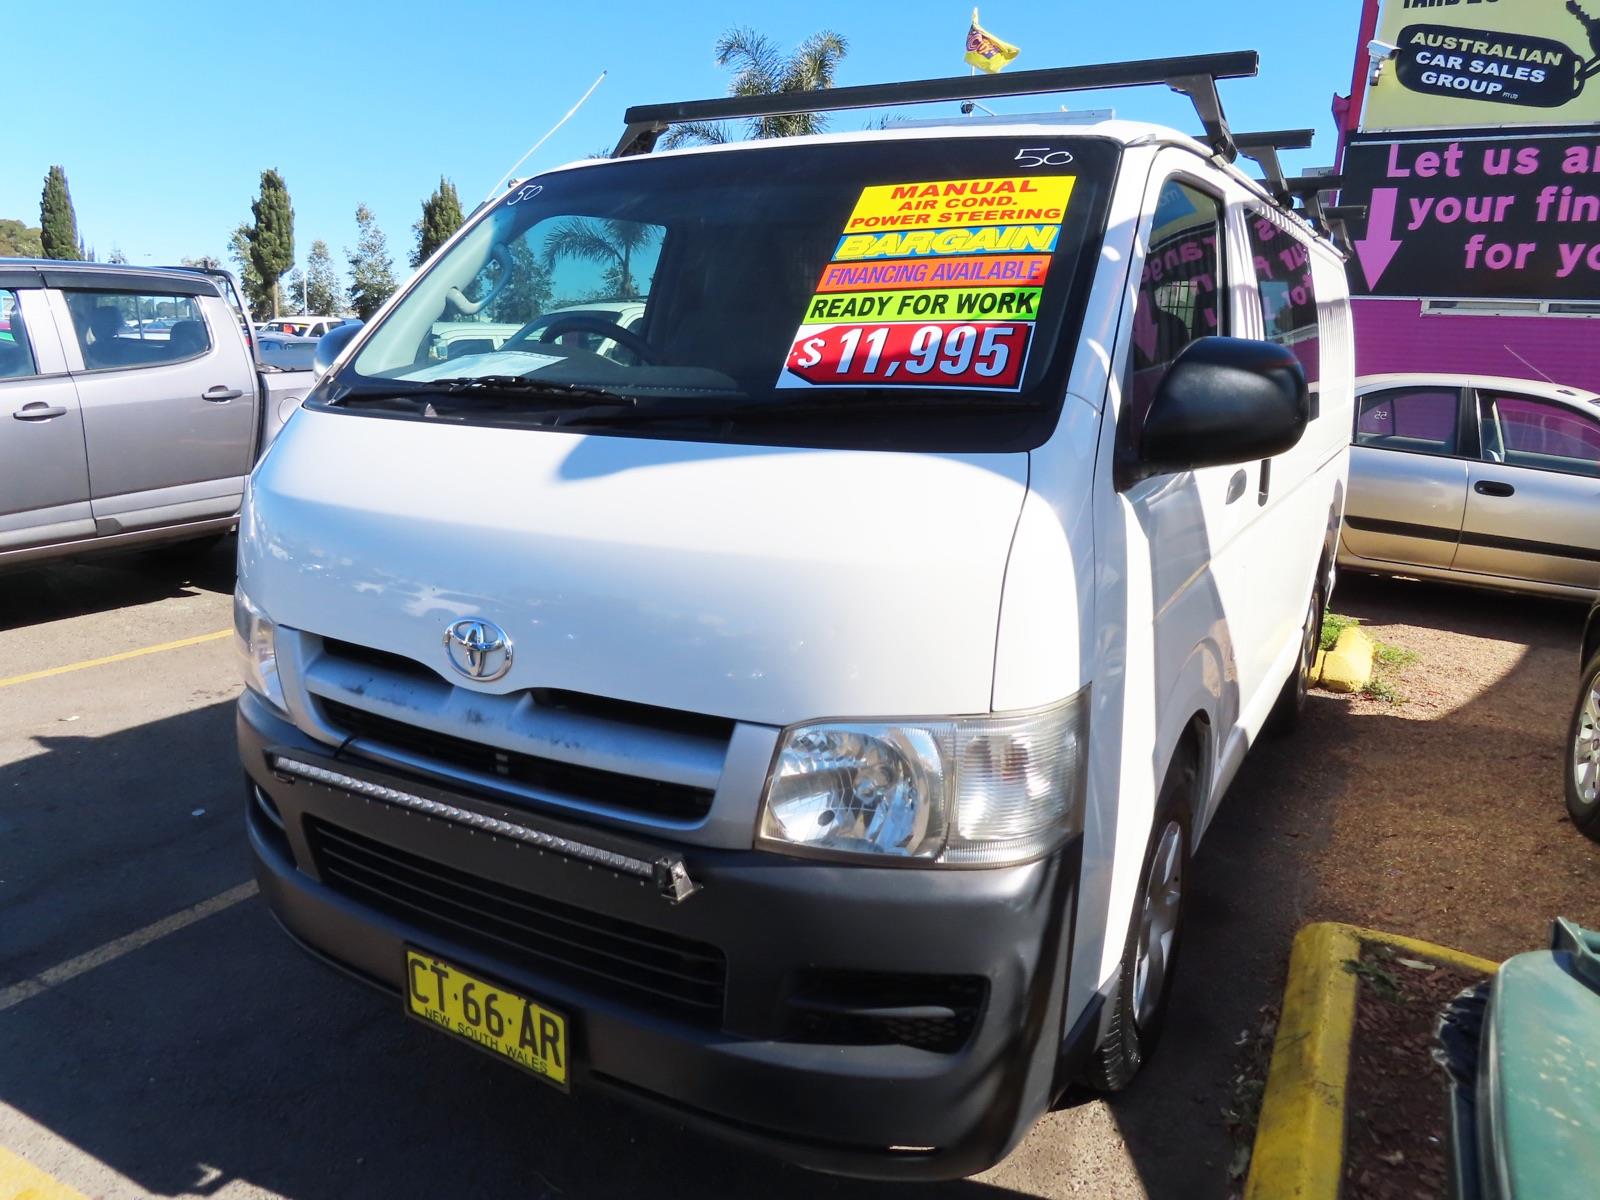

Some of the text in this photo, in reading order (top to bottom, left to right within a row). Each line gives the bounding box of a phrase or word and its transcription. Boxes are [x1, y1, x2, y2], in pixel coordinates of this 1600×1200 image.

[1411, 32, 1562, 66] AUSTRALIAN
[1416, 51, 1546, 83] CAR SALES
[1421, 71, 1503, 95] GROUP
[1014, 147, 1074, 168] 50
[1386, 143, 1463, 178] Let
[1482, 146, 1540, 176] us
[507, 185, 543, 206] 50
[891, 180, 1038, 200] MANUAL
[898, 195, 1018, 212] AIR COND.
[850, 208, 1062, 229] POWER STEERING
[1407, 186, 1600, 231] your fin
[834, 225, 1059, 260] BARGAIN
[1464, 234, 1536, 270] for
[825, 260, 1043, 287] FINANCING AVAILABLE
[810, 291, 1037, 319] READY FOR WORK
[424, 1007, 549, 1075] NEW SOUTH WALES
